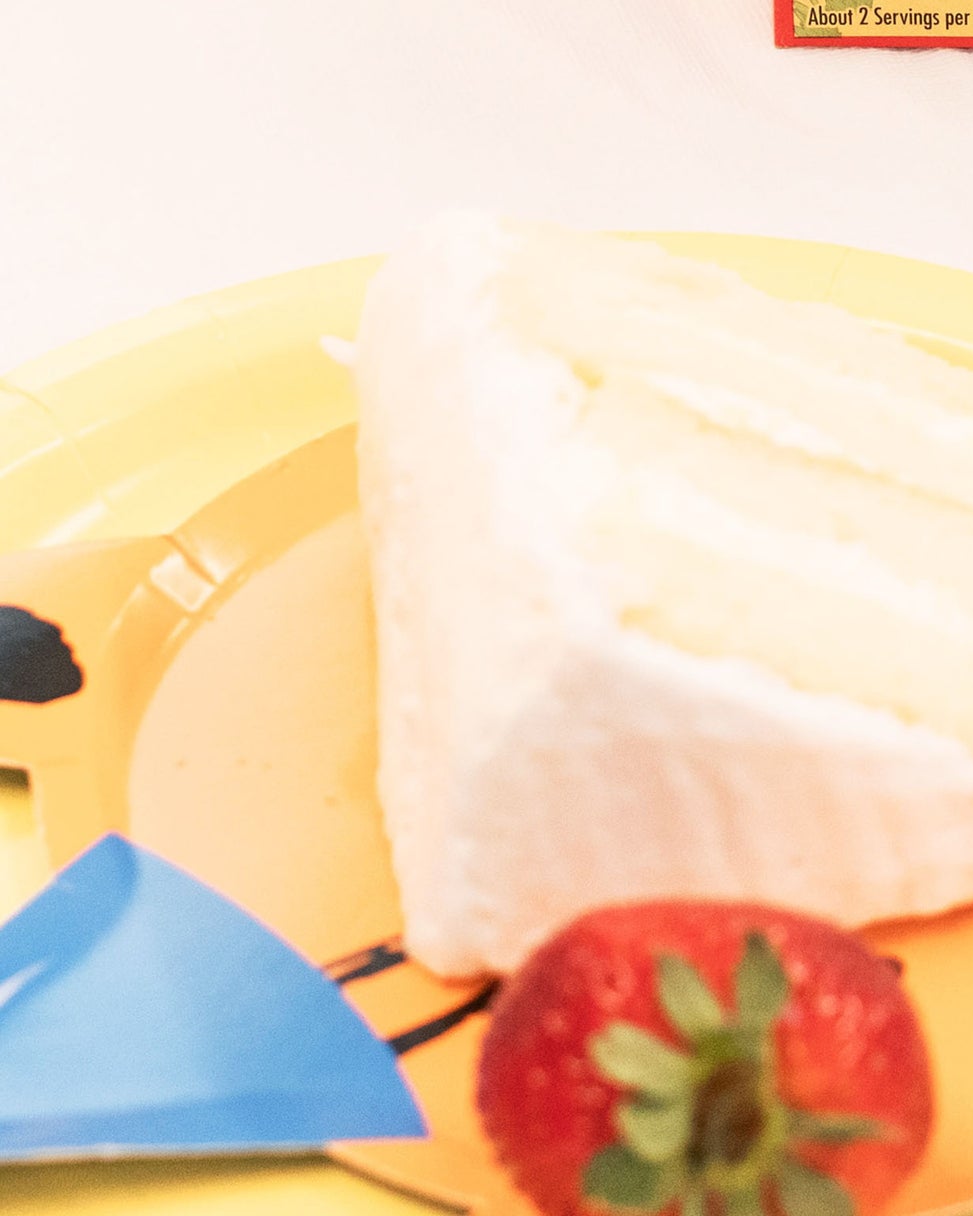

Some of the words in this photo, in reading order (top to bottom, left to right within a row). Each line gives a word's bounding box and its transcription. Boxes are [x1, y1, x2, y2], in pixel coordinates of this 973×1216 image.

[807, 5, 854, 26] About
[858, 6, 869, 26] 2
[873, 6, 940, 30] Servings
[944, 10, 971, 30] per
